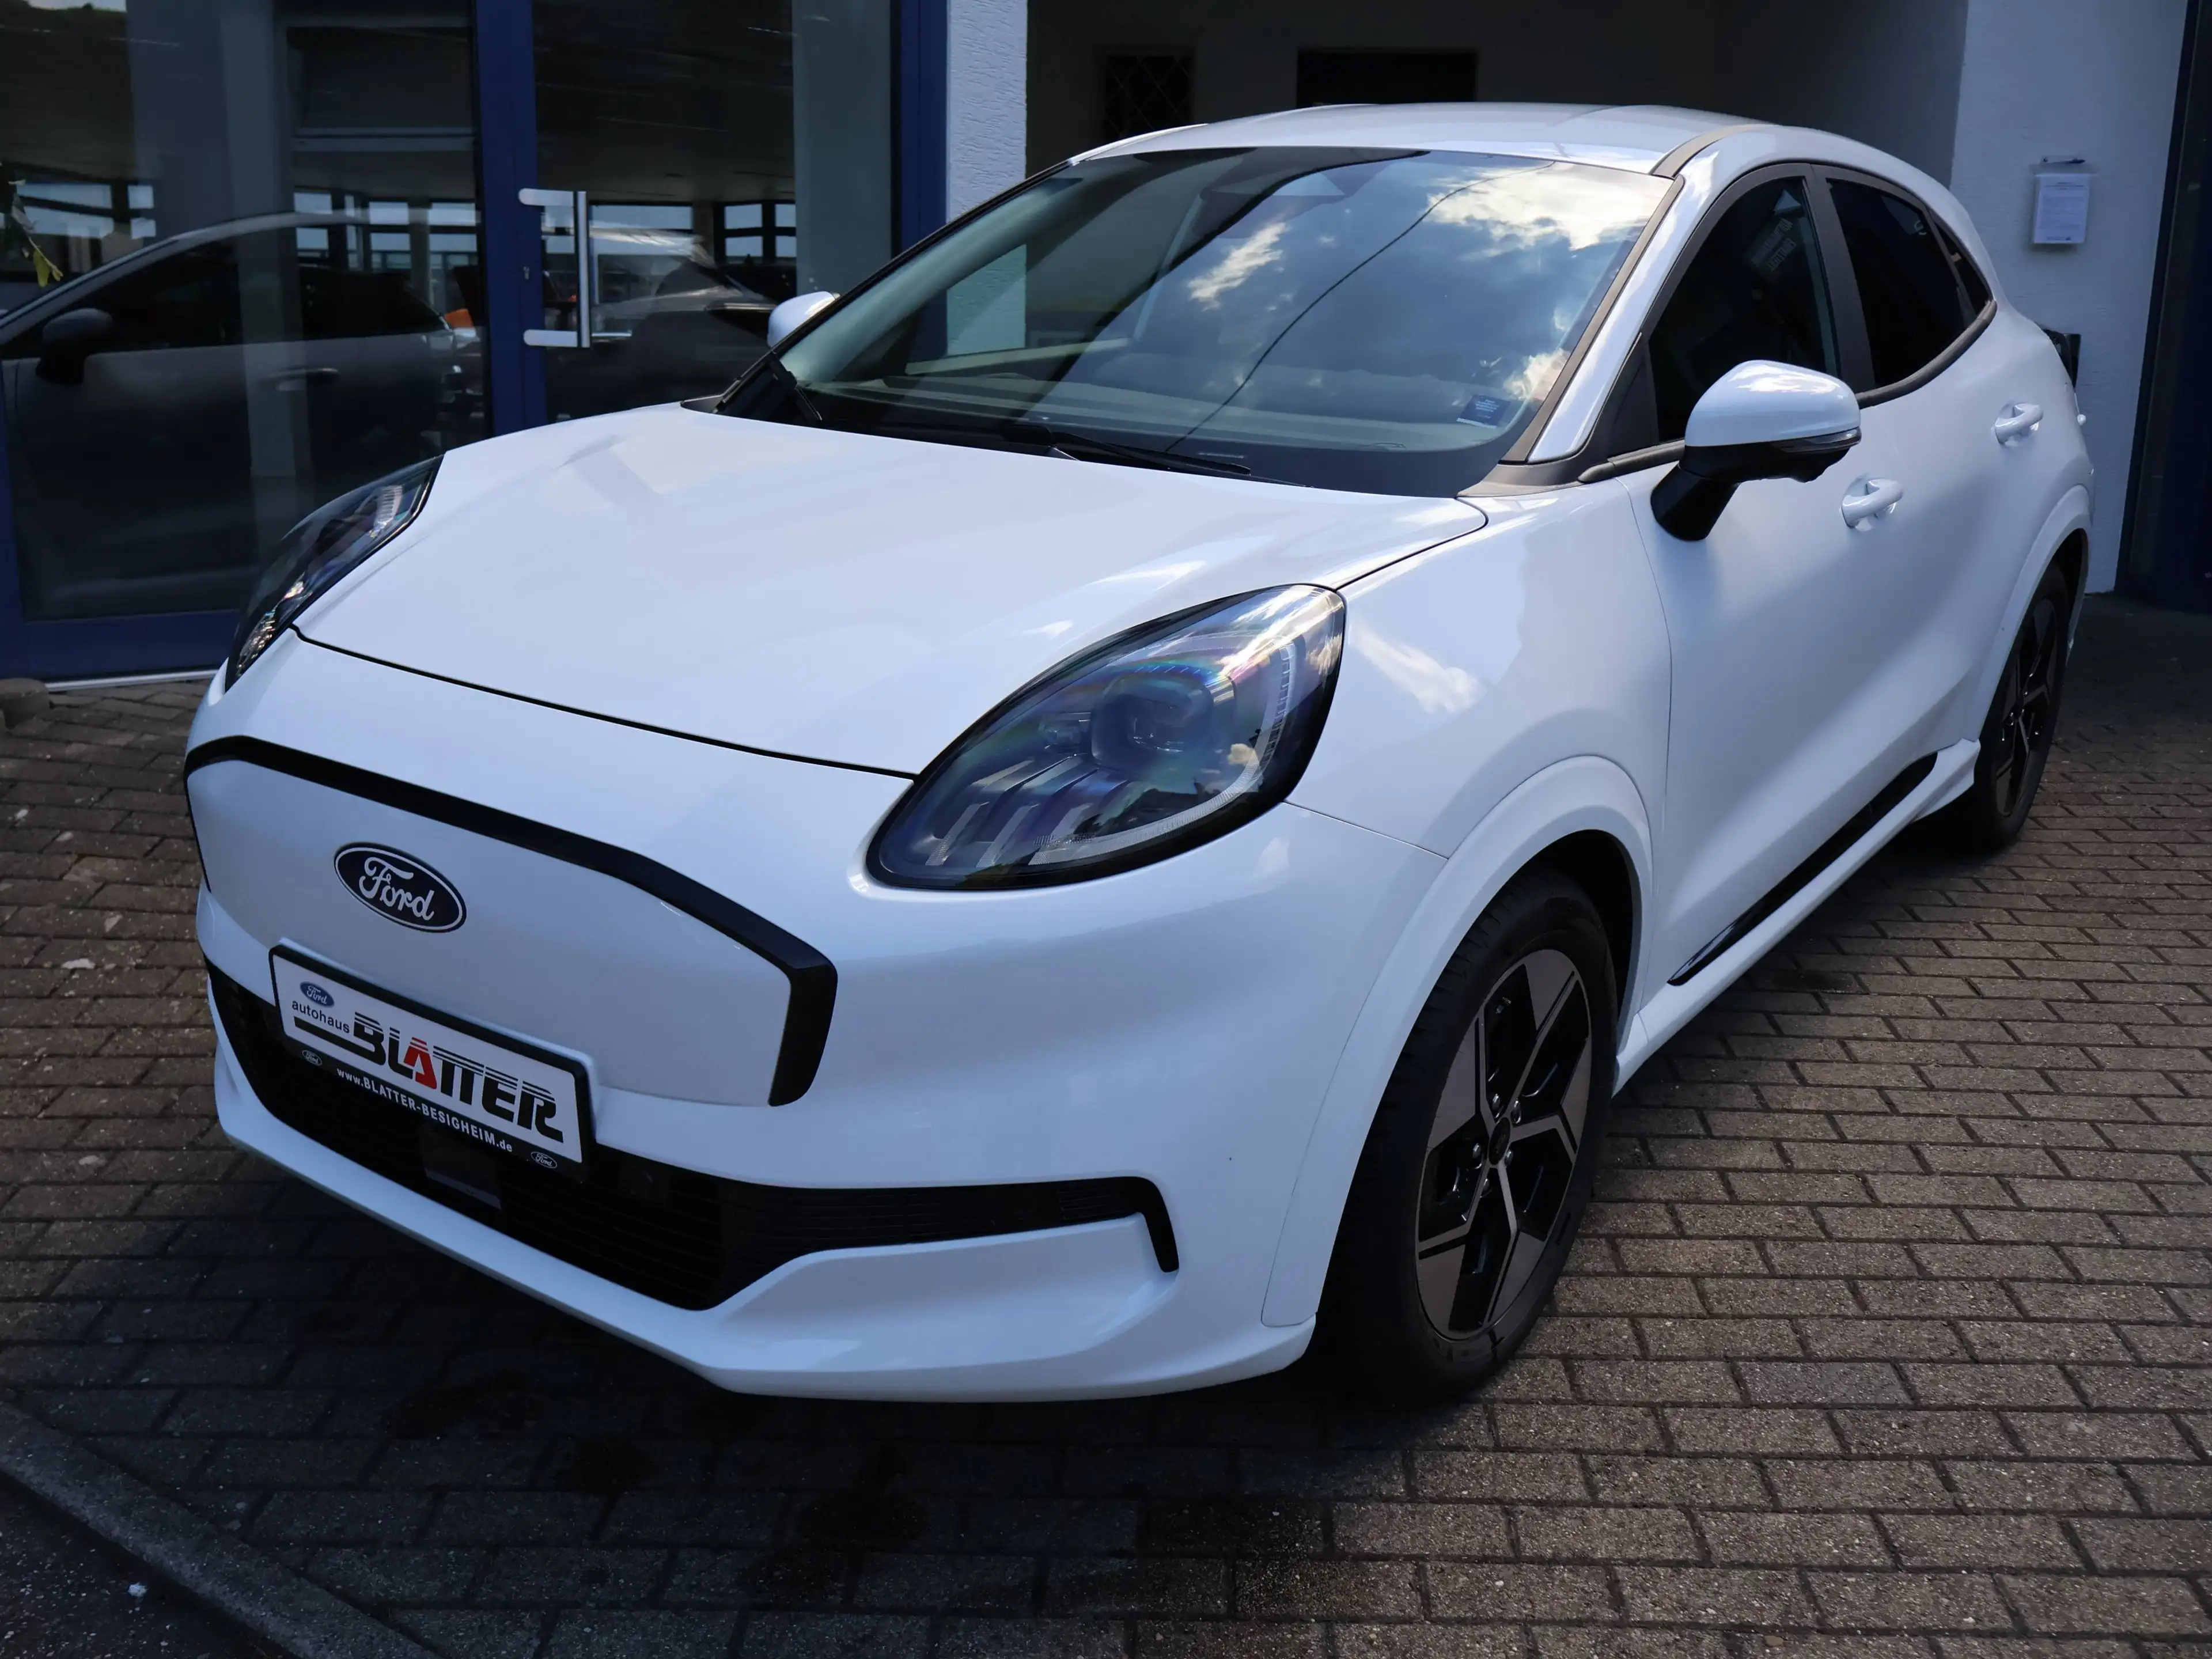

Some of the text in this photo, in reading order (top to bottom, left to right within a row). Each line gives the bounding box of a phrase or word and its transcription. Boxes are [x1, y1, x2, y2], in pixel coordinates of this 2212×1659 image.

[358, 856, 435, 921] Ford
[306, 985, 328, 1005] Ford
[291, 1000, 564, 1143] autohaus BLATTER
[336, 1067, 513, 1152] www.BLATTER-BESIGHEIM.de
[535, 1152, 554, 1166] Ford
